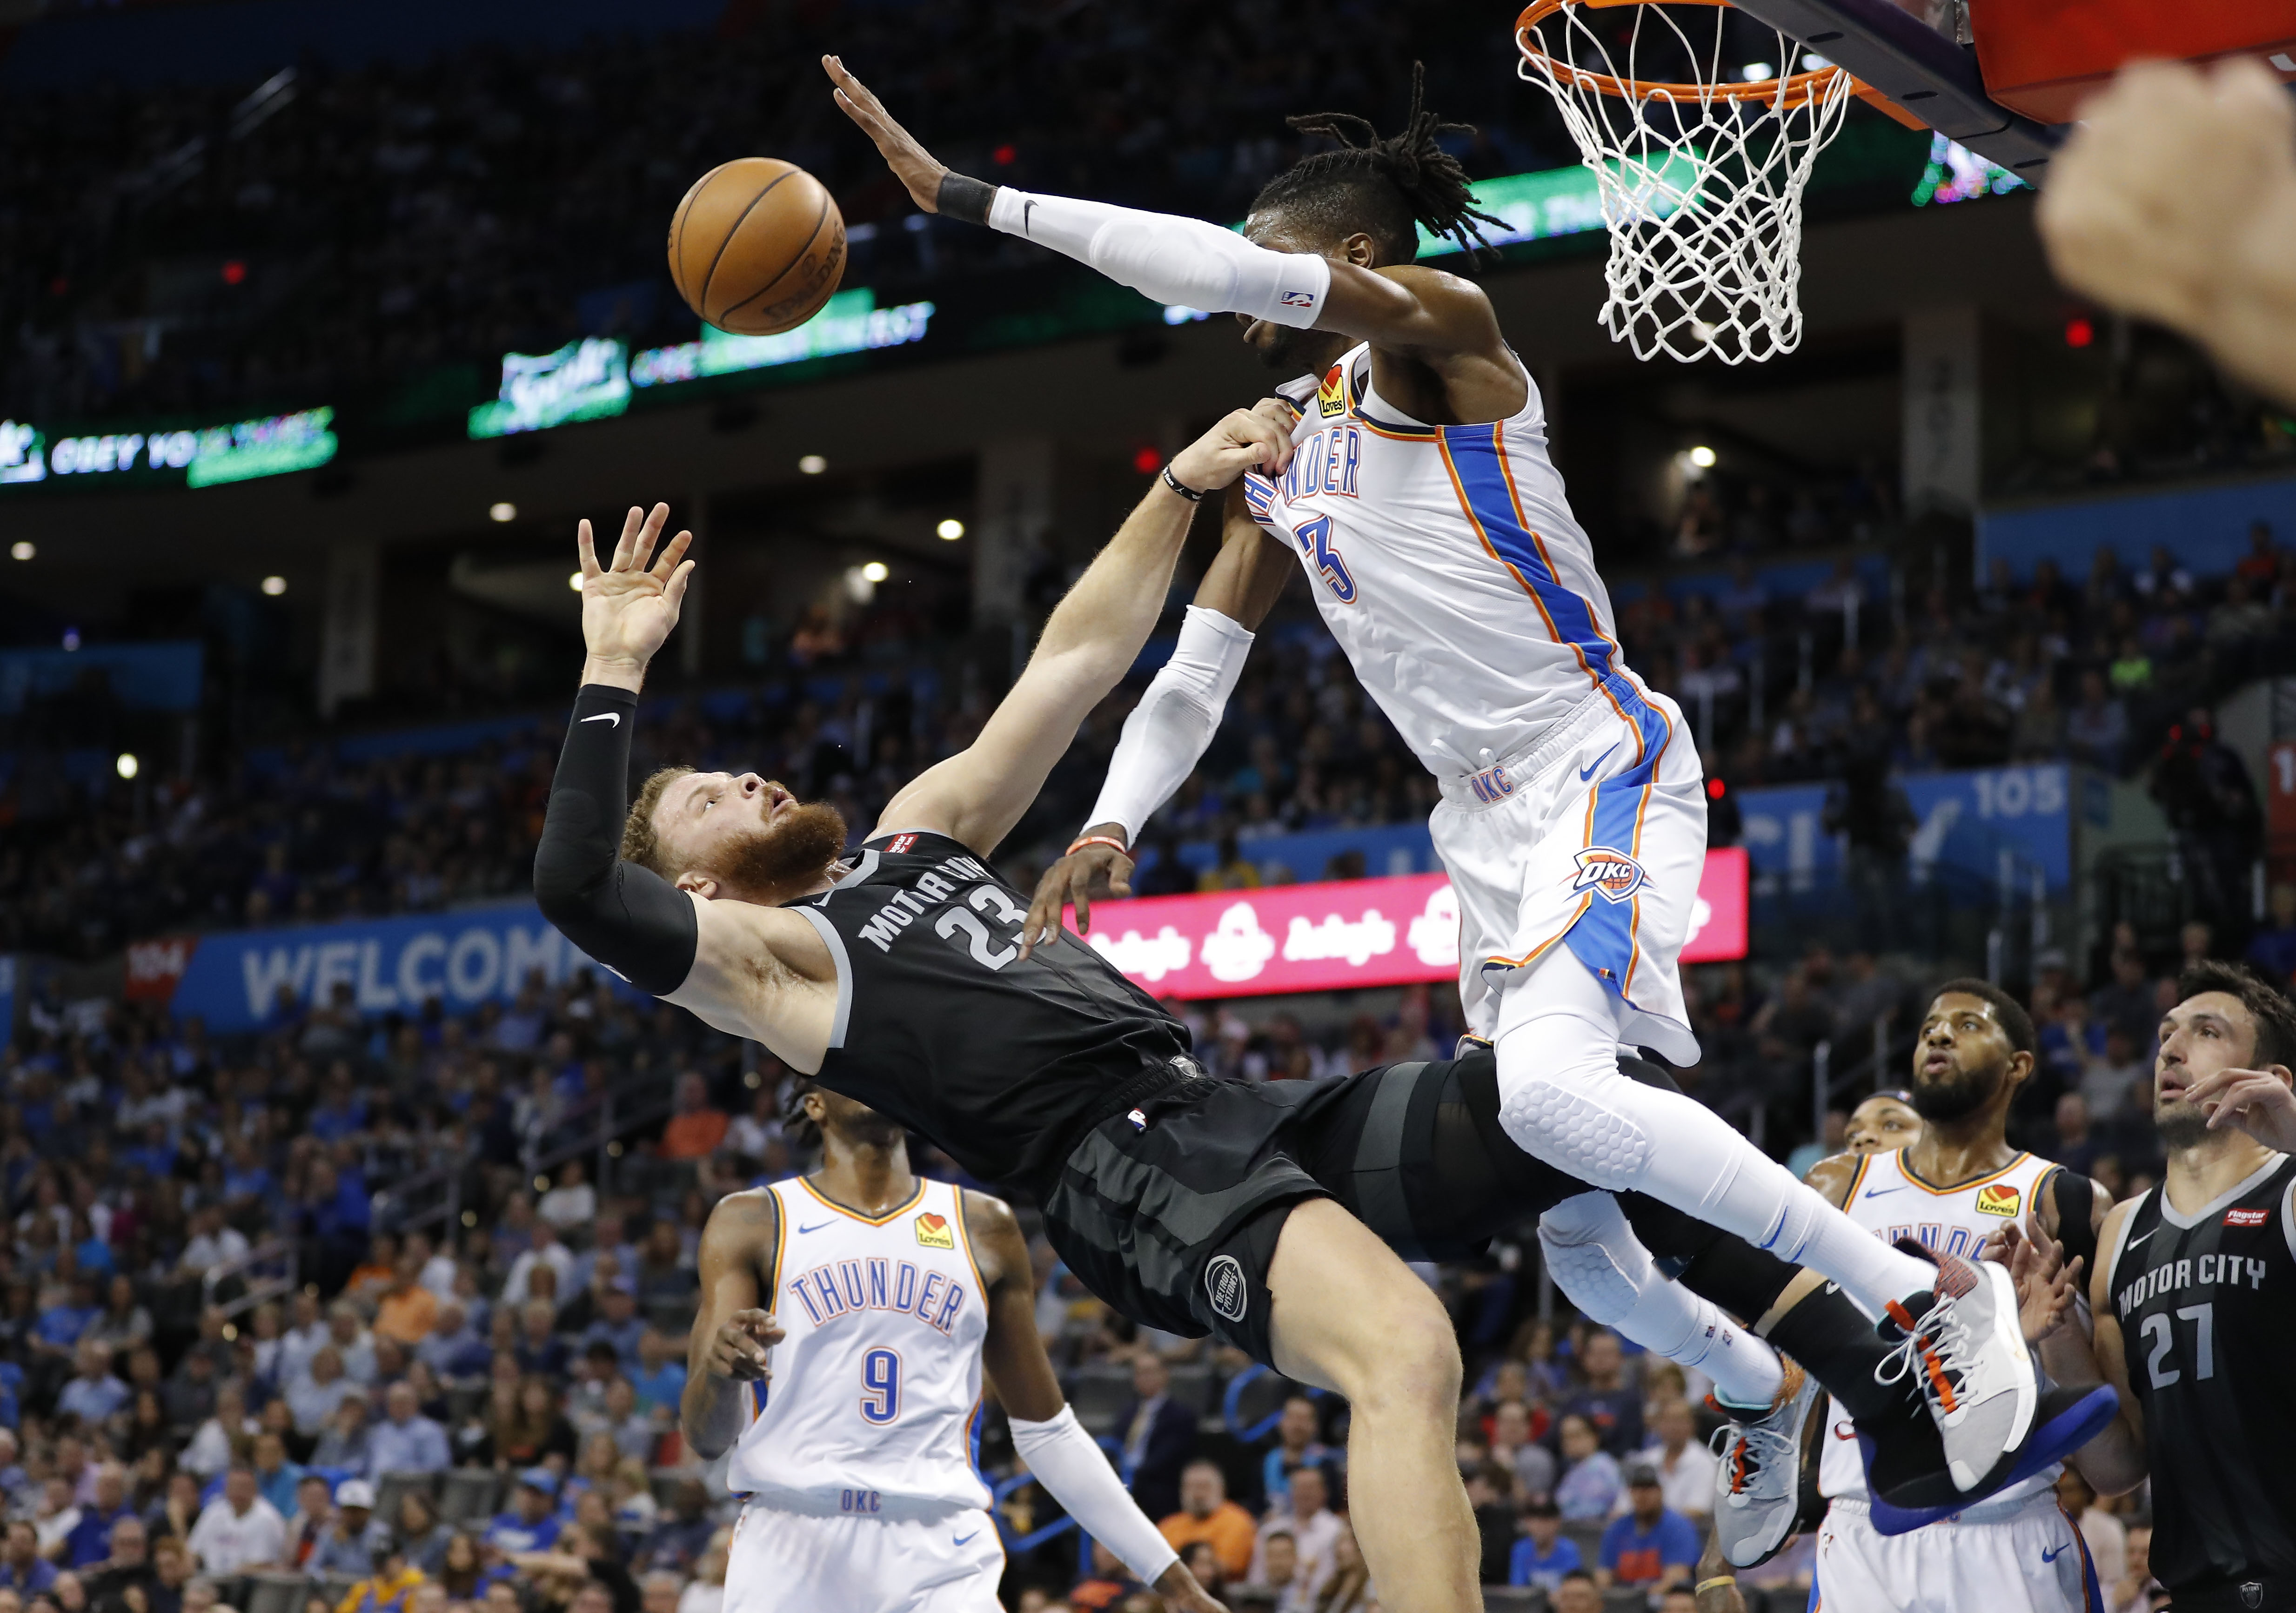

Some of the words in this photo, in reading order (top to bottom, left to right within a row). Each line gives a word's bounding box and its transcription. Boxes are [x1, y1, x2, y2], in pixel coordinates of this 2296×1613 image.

[1321, 395, 1343, 413] Love's
[1293, 514, 1358, 605] 3
[1471, 766, 1514, 804] OKC
[1972, 772, 2065, 818] 105
[1575, 861, 1632, 887] OKC
[935, 884, 1047, 971] 23
[1980, 1201, 2015, 1215] Love's
[2228, 1210, 2266, 1219] Flagstar
[918, 1232, 951, 1248] Love's
[787, 1257, 967, 1337] THUNDER
[1215, 1266, 1232, 1304] DETROIT
[1223, 1272, 1238, 1311] PISTONS
[2118, 1258, 2191, 1324] MOTOR
[2198, 1254, 2266, 1290] CITY
[2141, 1302, 2214, 1390] 27
[860, 1346, 903, 1425] 9
[841, 1489, 881, 1513] OKC
